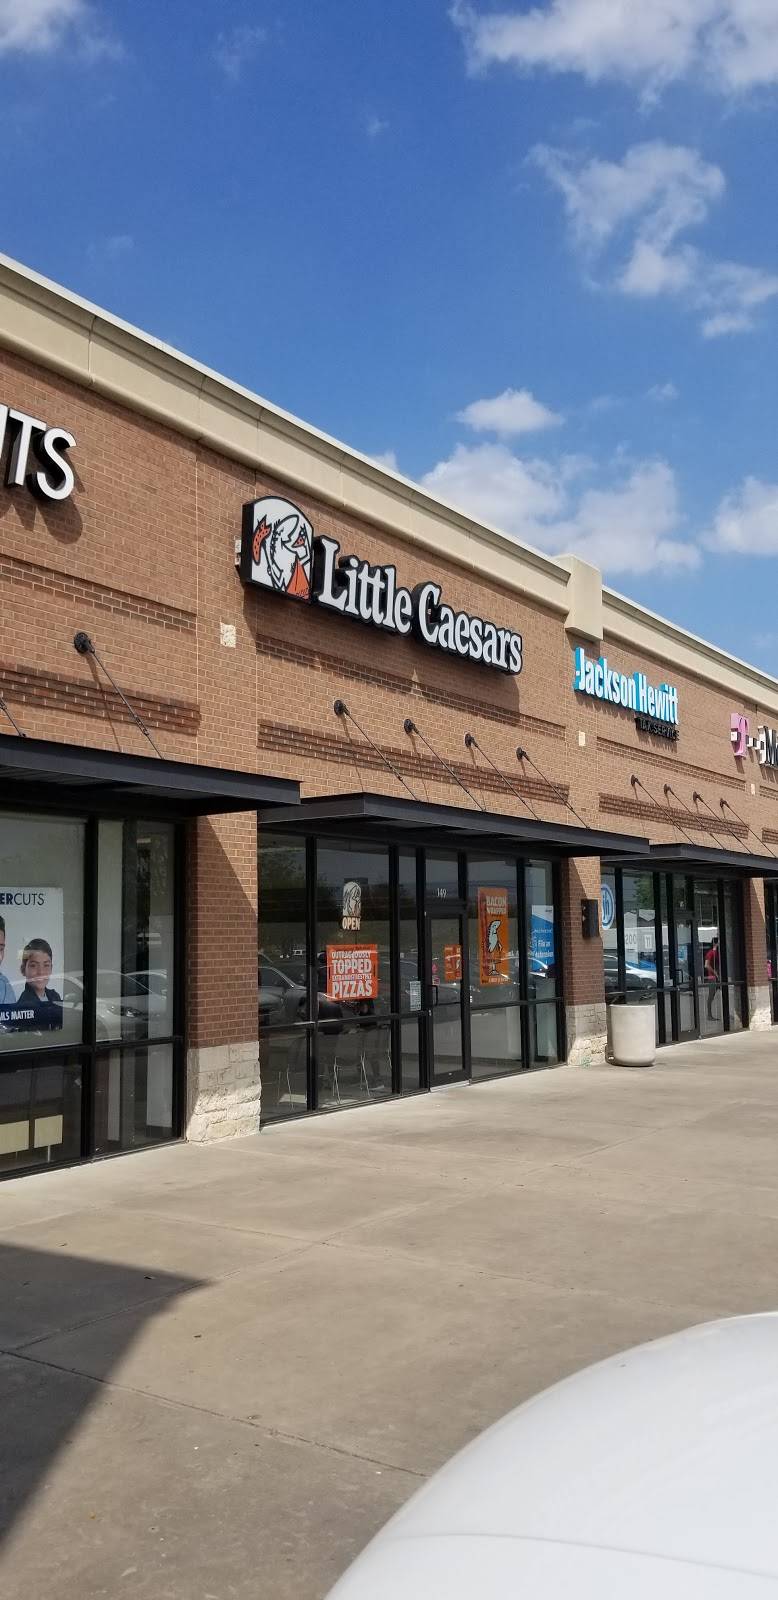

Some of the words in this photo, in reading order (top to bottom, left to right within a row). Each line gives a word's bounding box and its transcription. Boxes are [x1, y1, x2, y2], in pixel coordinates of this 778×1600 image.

[317, 538, 412, 634] Little
[419, 584, 523, 673] Caesars
[574, 646, 637, 710] Jackson
[638, 672, 679, 725] Hewitt
[437, 888, 448, 899] 149
[486, 896, 507, 907] BACON
[342, 917, 361, 931] OPEN
[331, 958, 372, 975] TOPPED
[332, 980, 373, 999] PIZZAS
[11, 1009, 35, 1020] MATTER
